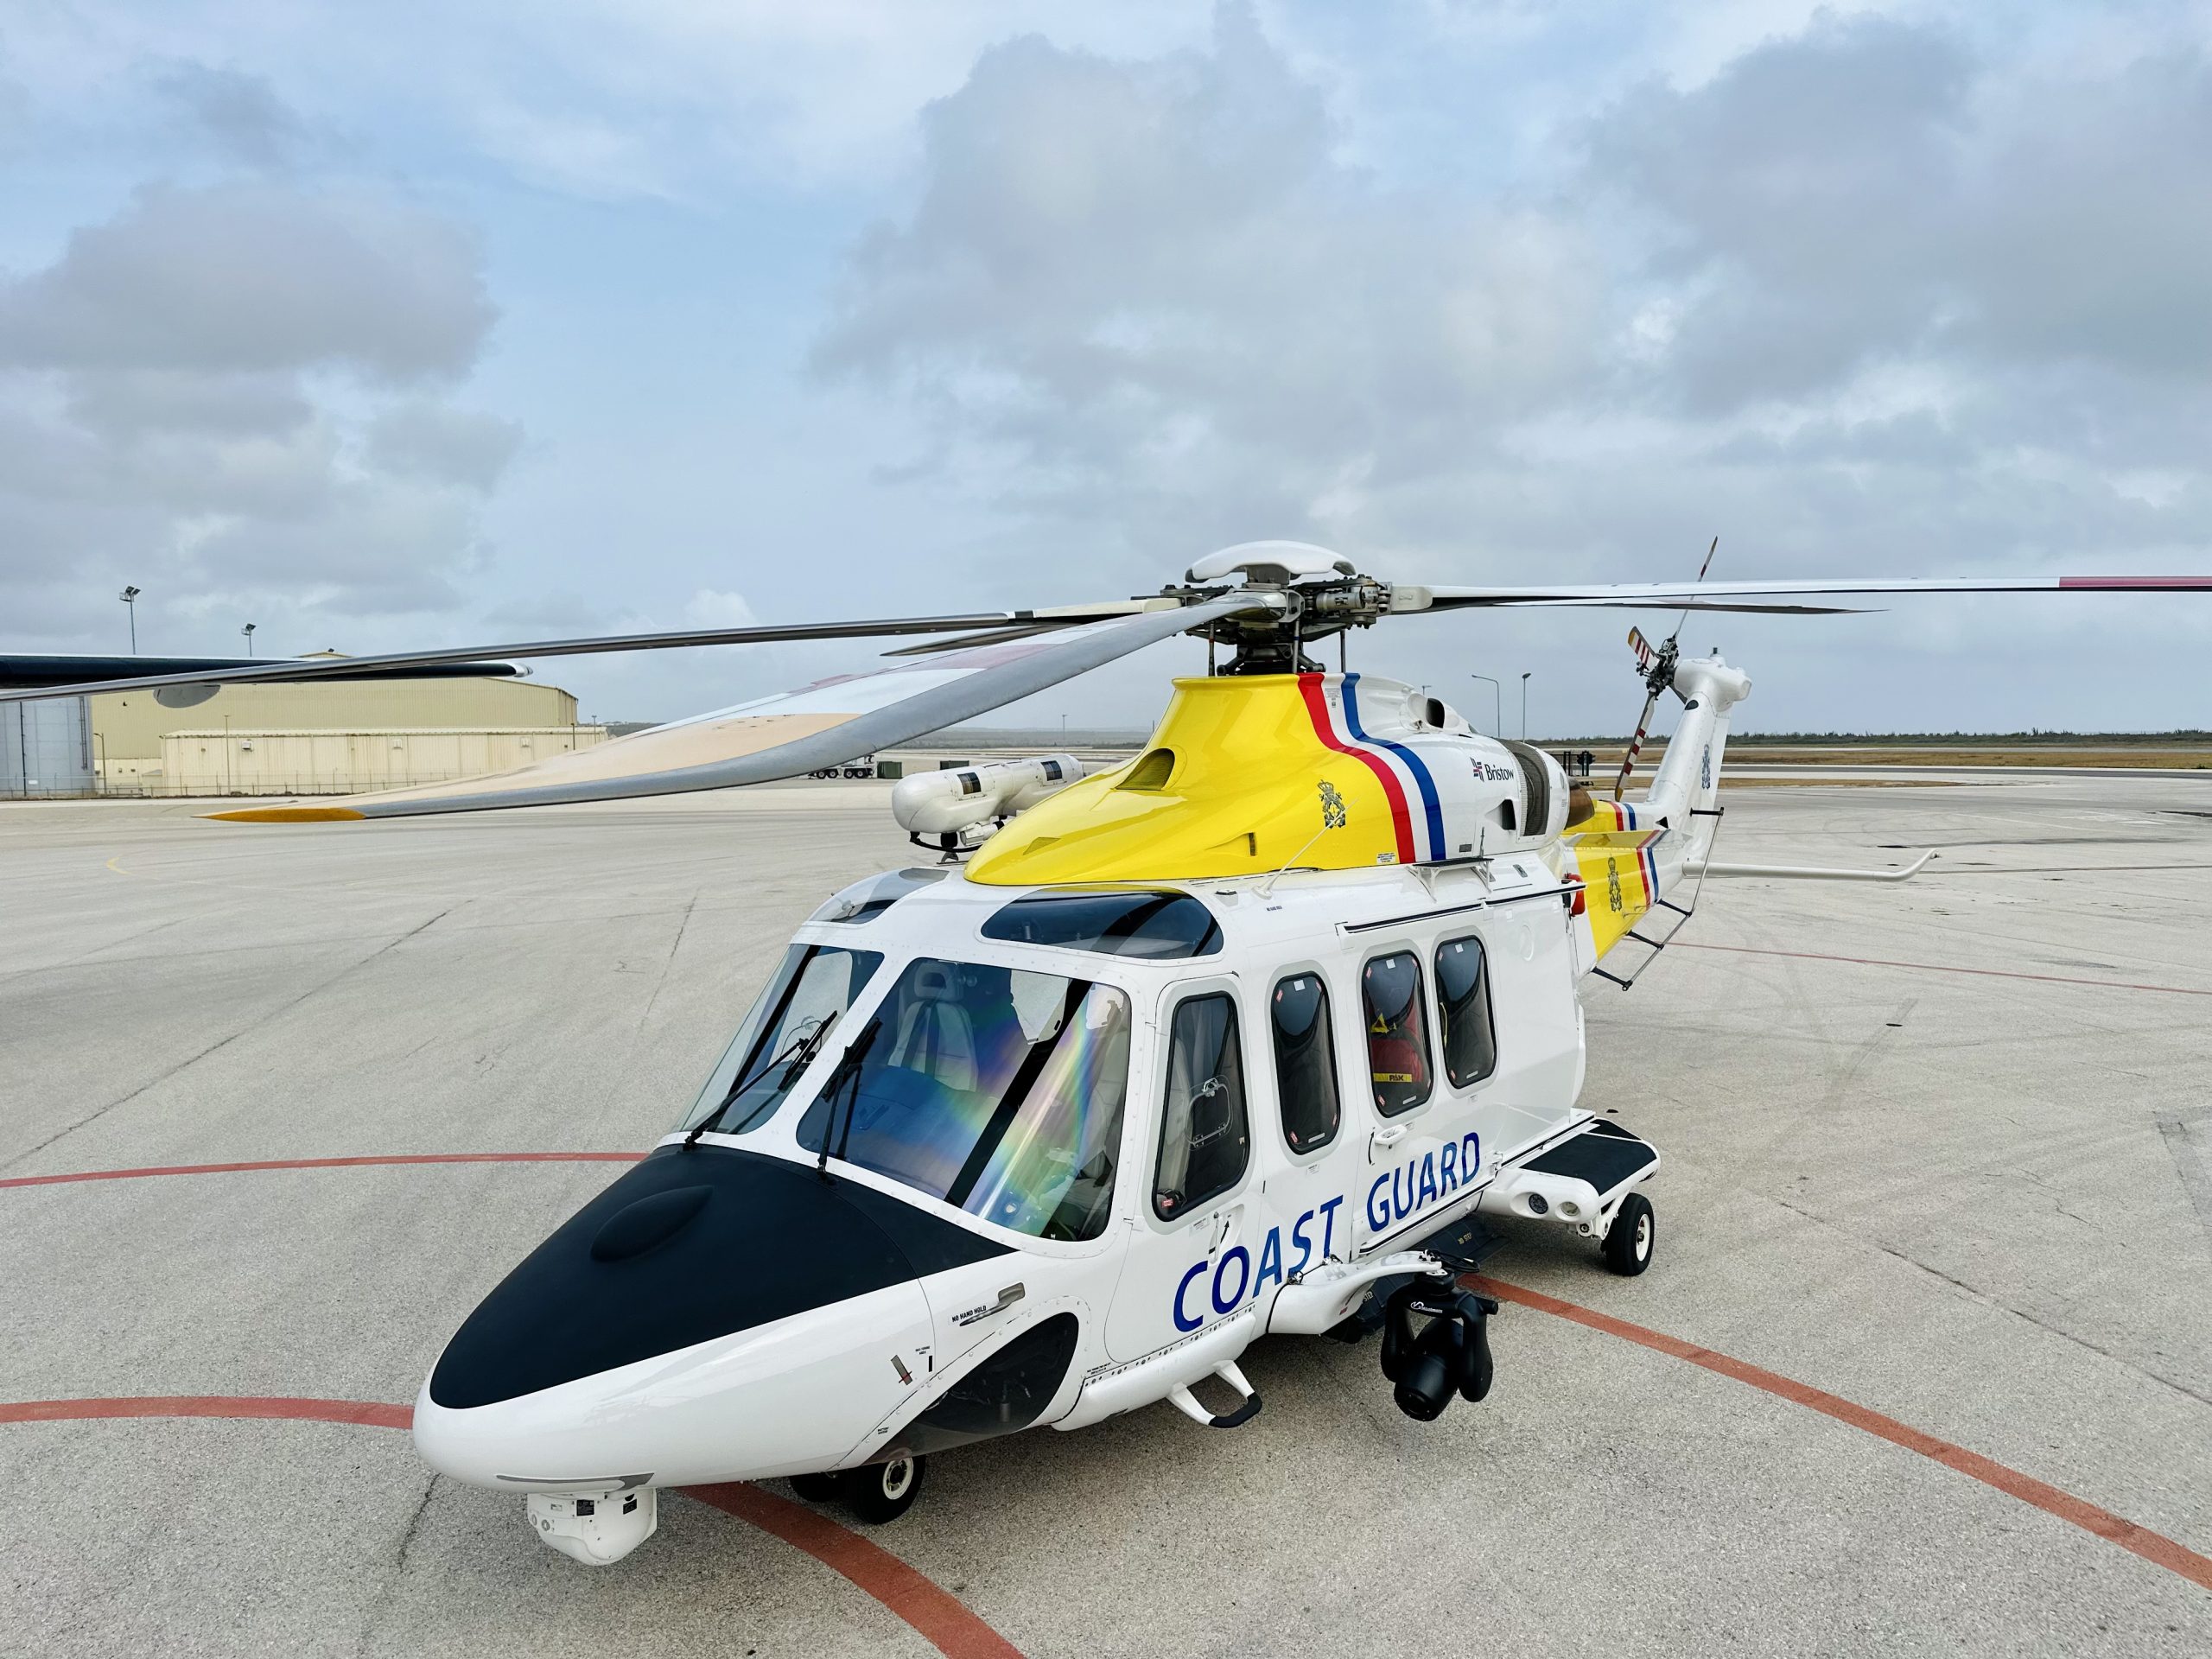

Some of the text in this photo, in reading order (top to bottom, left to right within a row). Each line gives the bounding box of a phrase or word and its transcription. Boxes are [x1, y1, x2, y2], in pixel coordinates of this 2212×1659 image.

[1484, 763, 1514, 781] Bristow
[1173, 1132, 1481, 1333] COAST GUARD
[959, 1310, 973, 1319] HAND
[974, 1305, 987, 1313] HOLD
